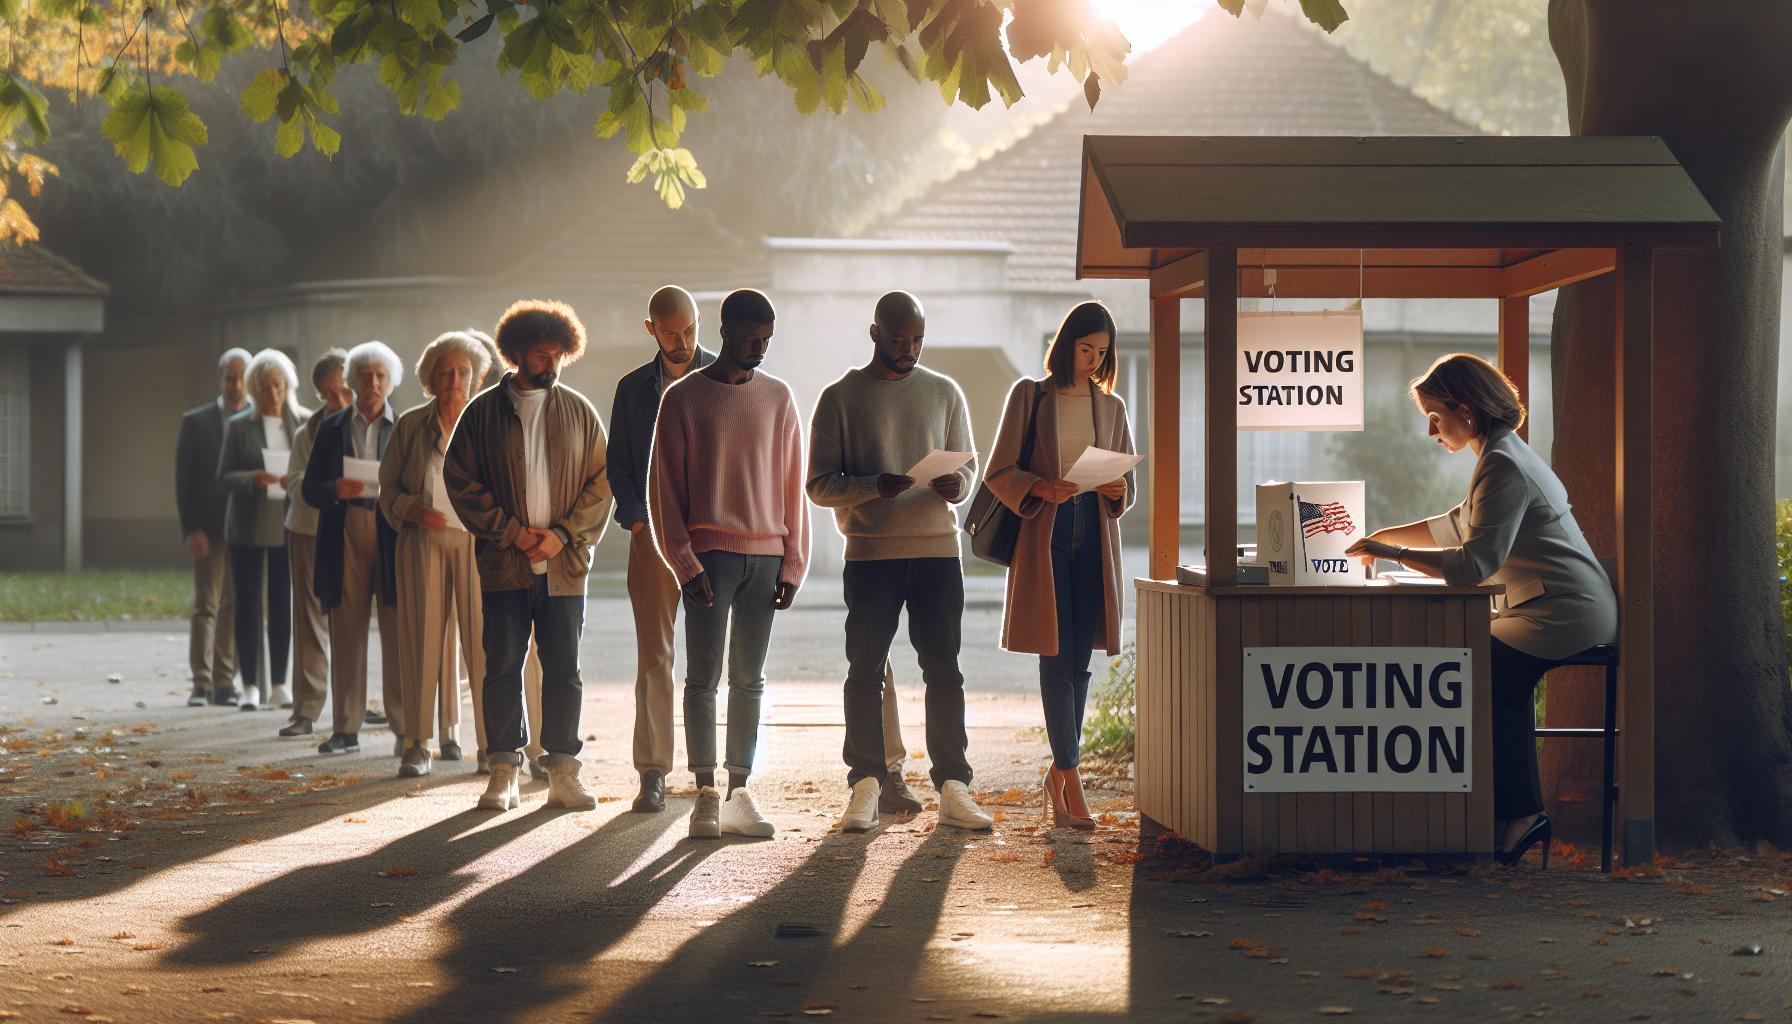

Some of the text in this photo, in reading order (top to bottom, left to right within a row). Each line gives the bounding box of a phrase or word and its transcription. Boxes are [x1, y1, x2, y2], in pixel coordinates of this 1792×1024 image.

[1243, 350, 1354, 373] VOTING
[1238, 385, 1343, 406] STATION
[1311, 559, 1349, 573] VOTE
[1260, 661, 1462, 709] VOTING
[1247, 725, 1465, 775] STATION
